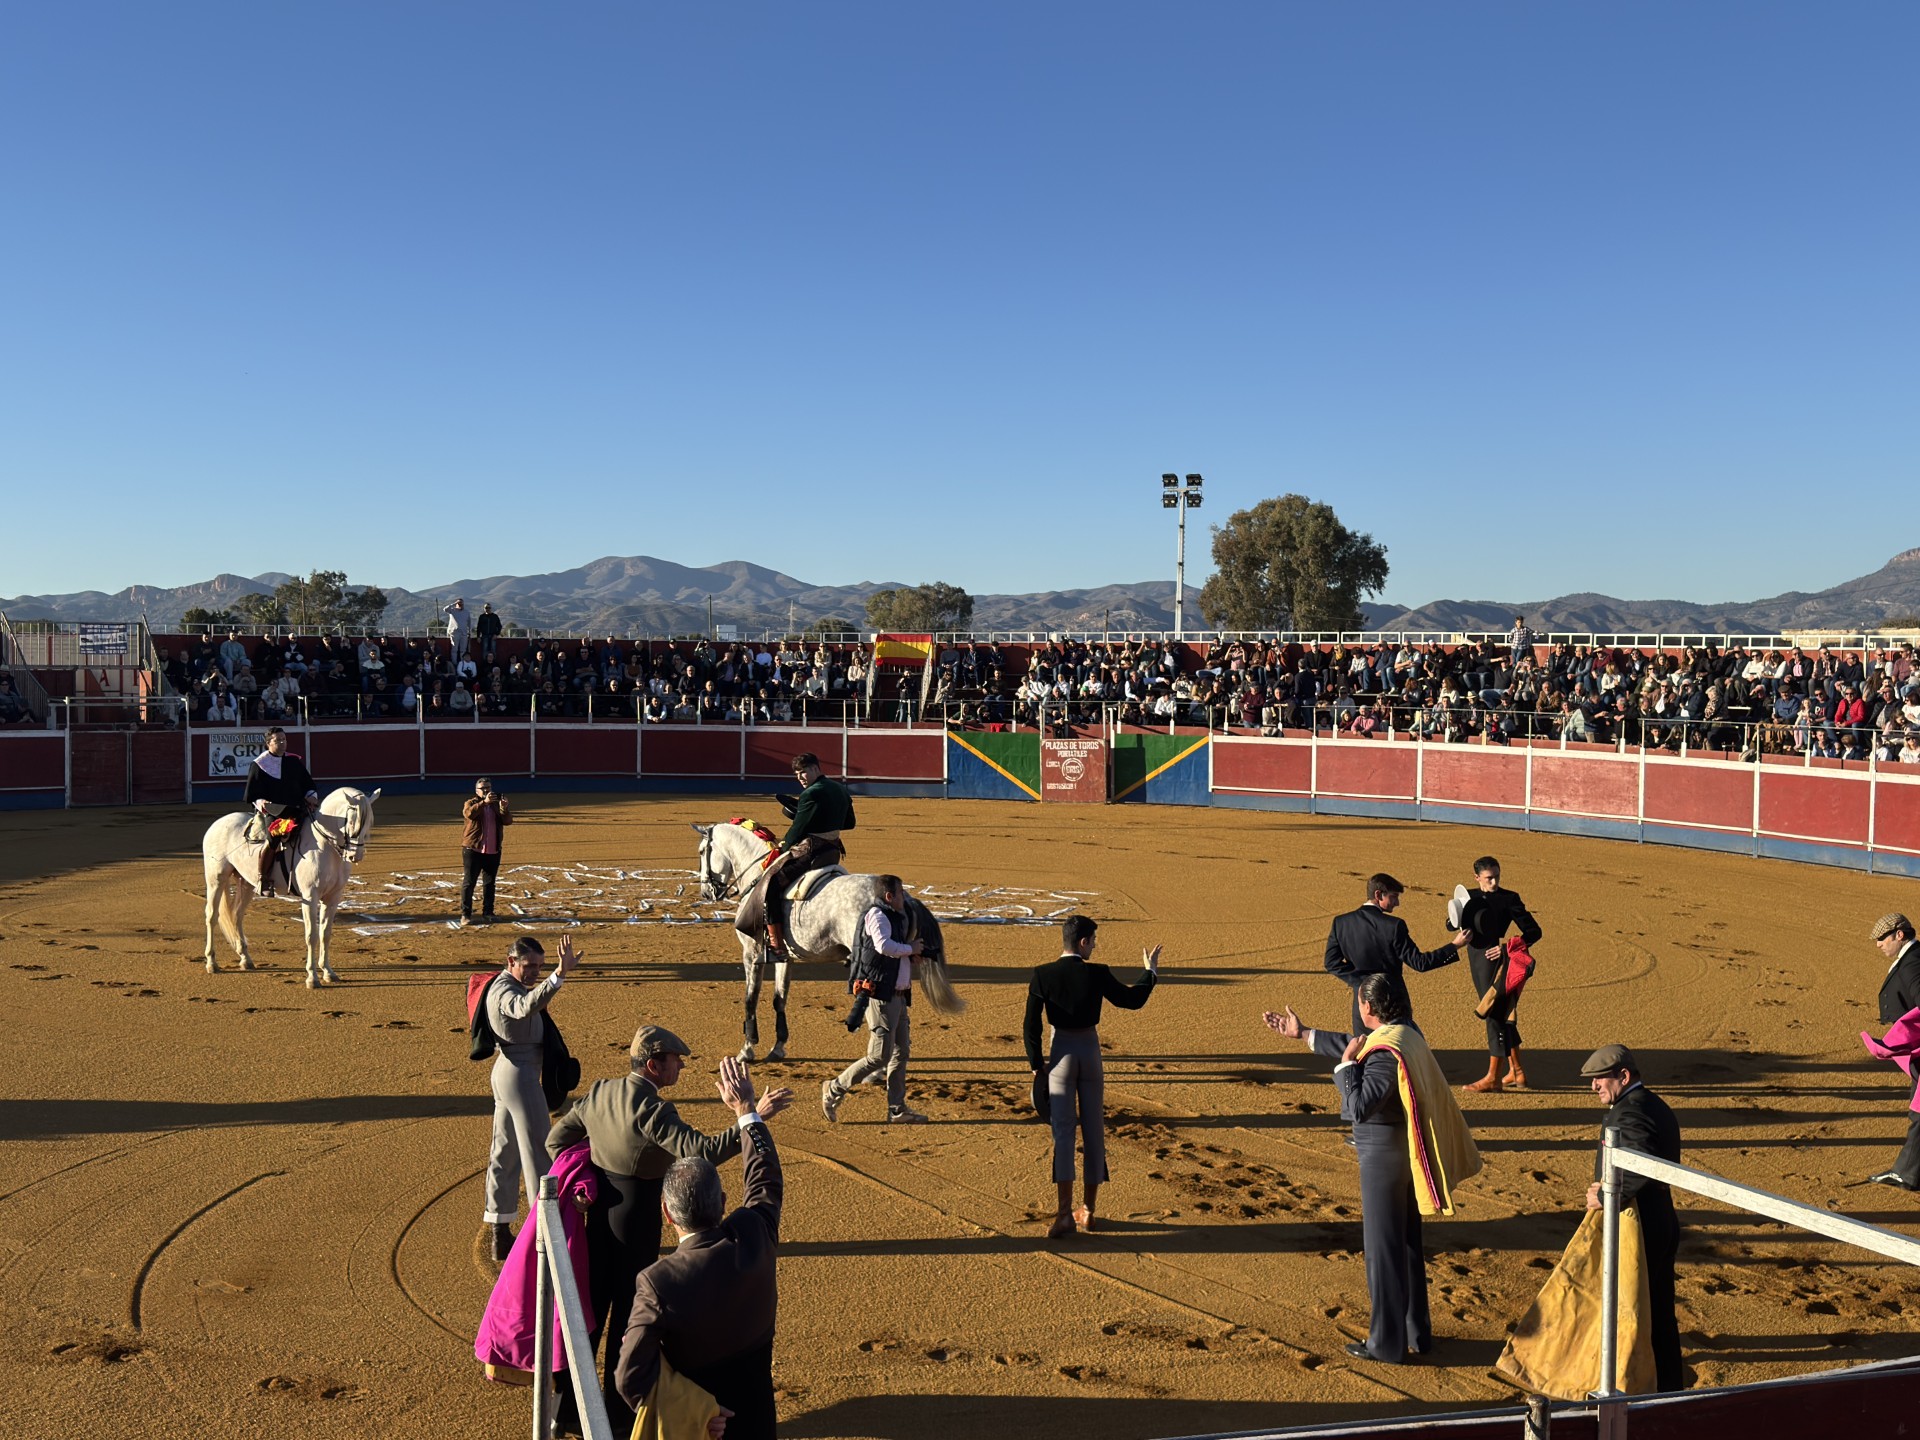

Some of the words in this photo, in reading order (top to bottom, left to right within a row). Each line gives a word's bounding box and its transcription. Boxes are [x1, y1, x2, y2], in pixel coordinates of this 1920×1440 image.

[211, 734, 240, 743] EVENTOS
[242, 734, 267, 743] TAURIN
[1045, 741, 1069, 750] PLAZAS
[1069, 741, 1078, 750] DE
[1078, 741, 1099, 750] TOROS
[233, 744, 265, 757] GRI
